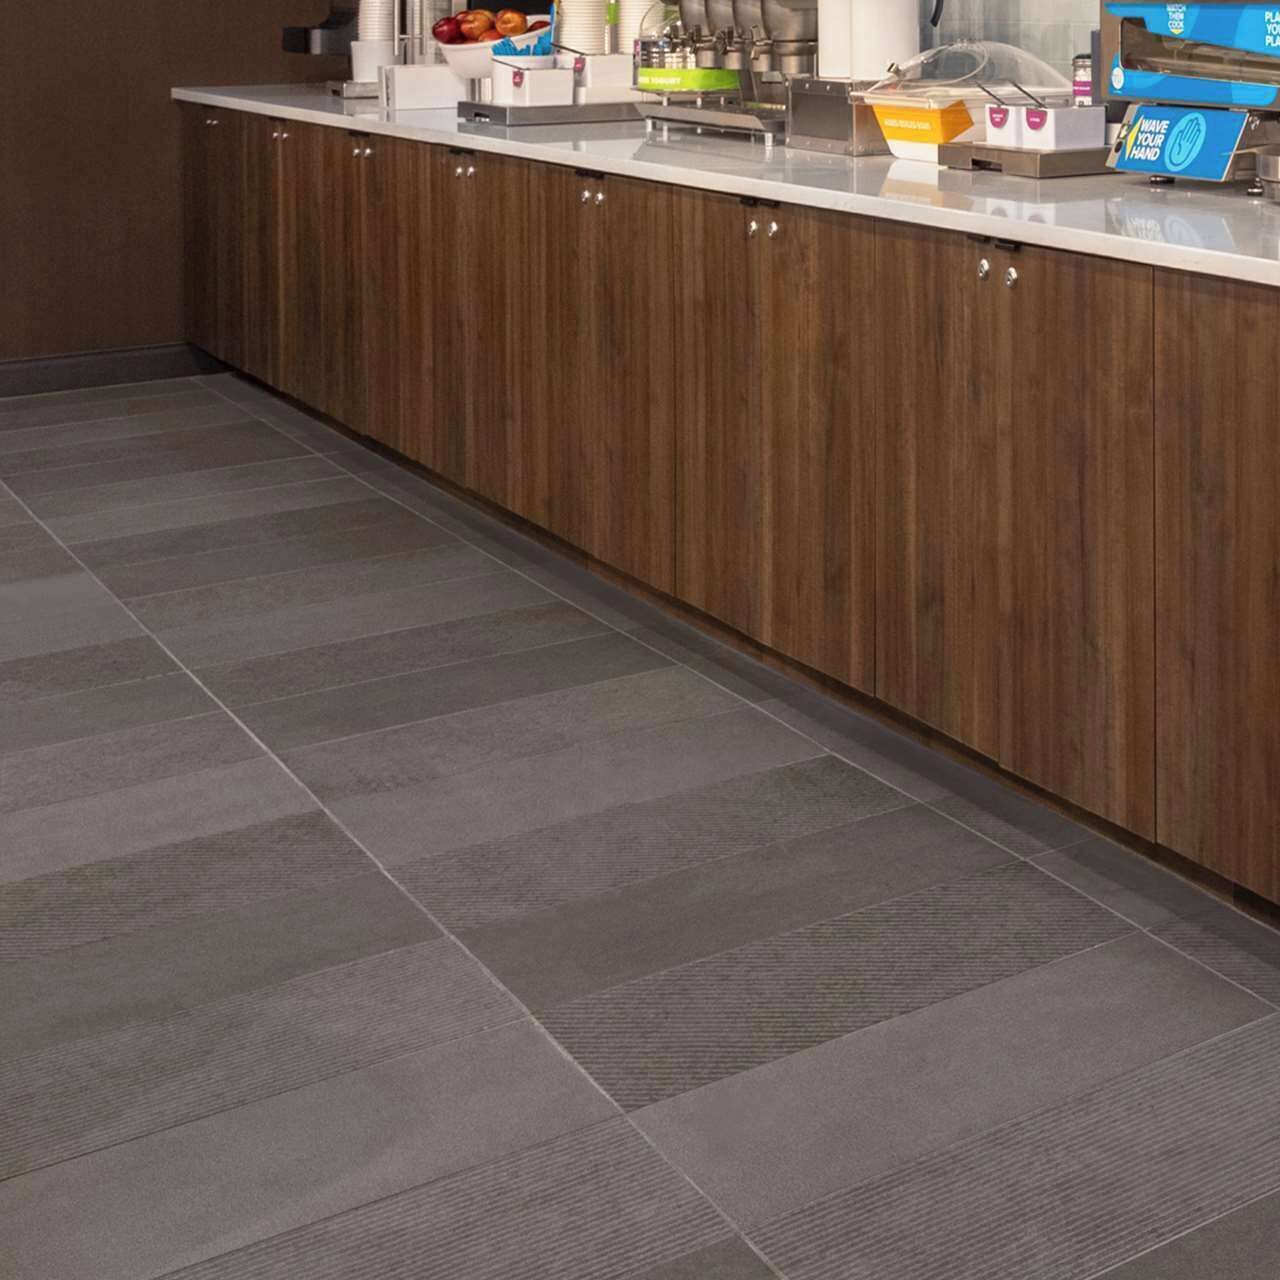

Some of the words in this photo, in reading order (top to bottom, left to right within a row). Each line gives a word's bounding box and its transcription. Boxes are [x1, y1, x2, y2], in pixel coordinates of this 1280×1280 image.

[1140, 119, 1170, 133] WAVE
[1137, 133, 1165, 147] YOUR
[1130, 147, 1160, 161] HAND
